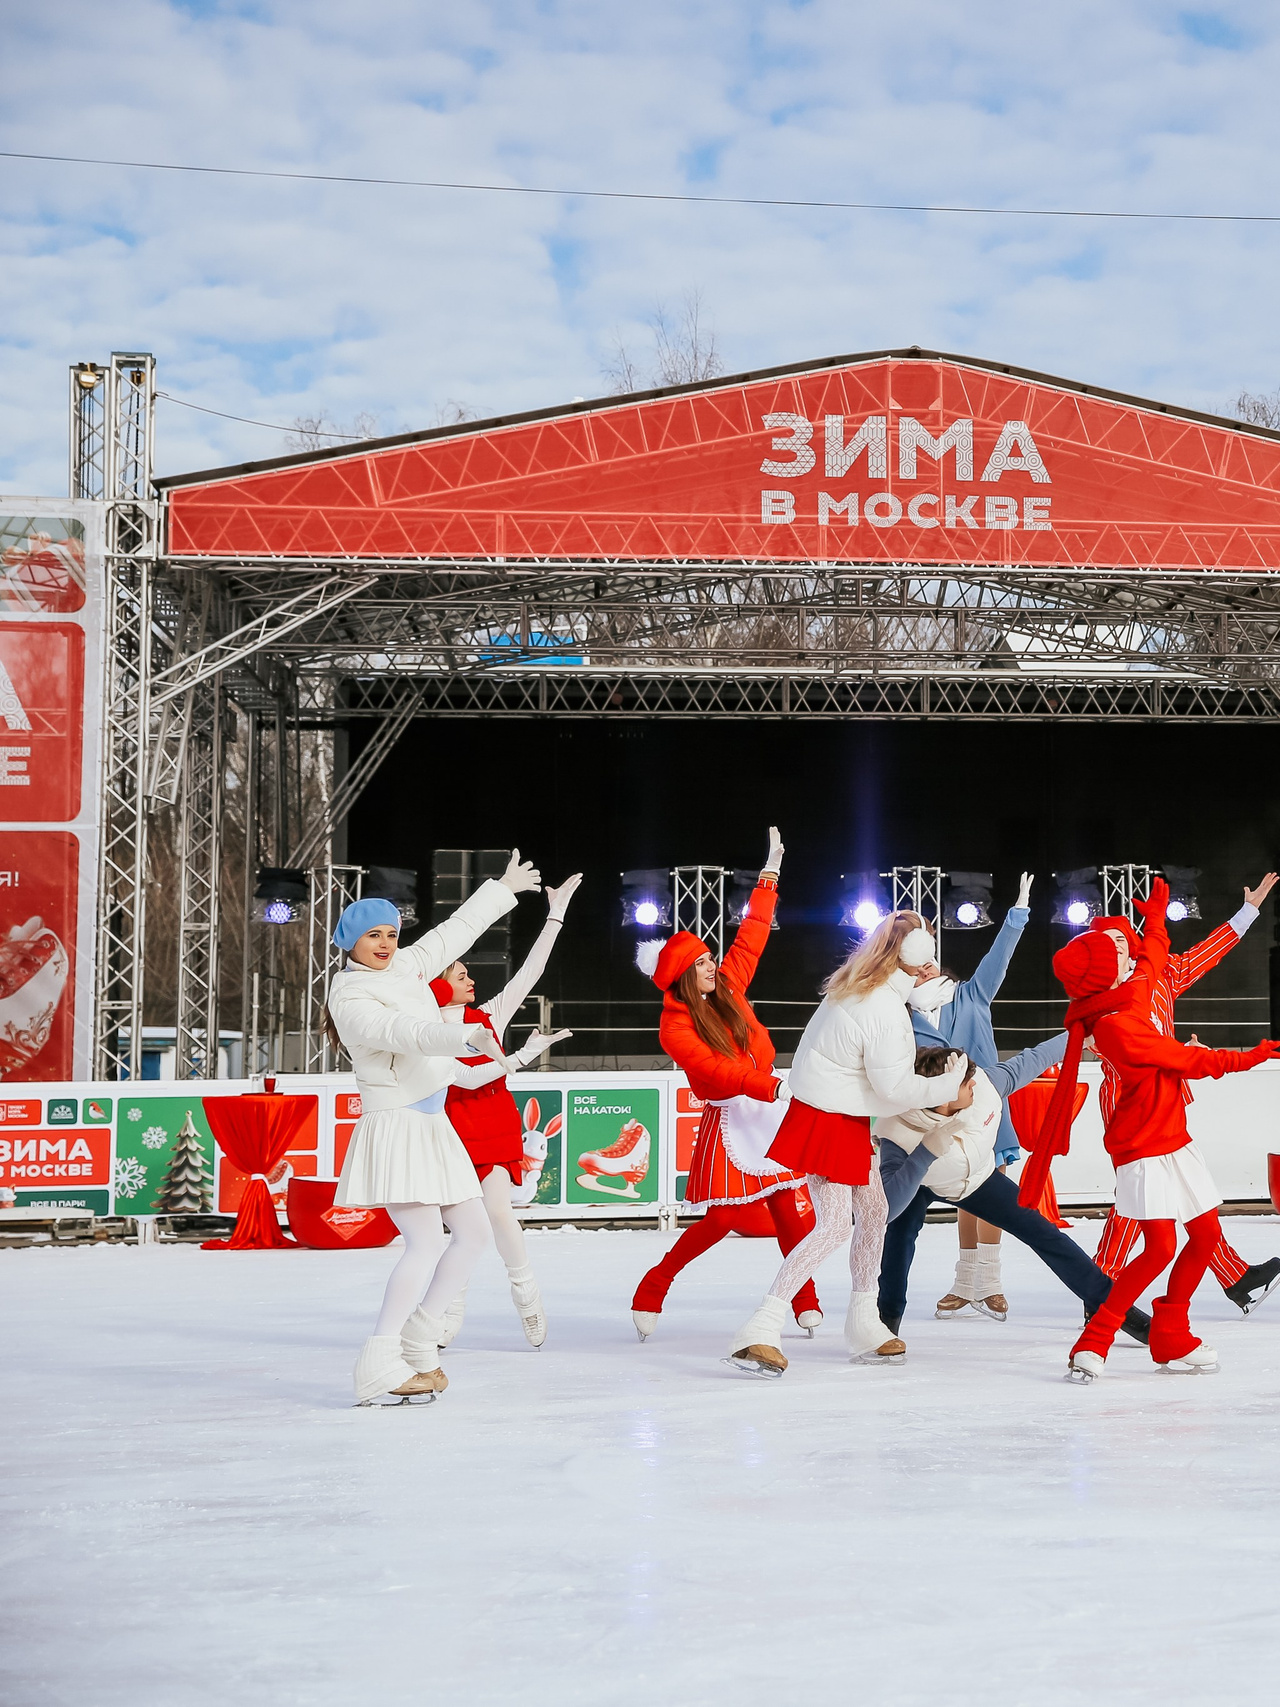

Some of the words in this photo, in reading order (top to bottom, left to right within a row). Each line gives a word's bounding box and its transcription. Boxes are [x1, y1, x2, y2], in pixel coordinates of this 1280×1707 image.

[759, 412, 1052, 483] ЗИМА
[761, 490, 796, 524] В
[818, 492, 1052, 531] МОСКВЕ
[574, 1096, 597, 1105] ВСЕ
[574, 1106, 591, 1115] НА
[592, 1105, 632, 1115] КАТОК!
[10, 1163, 93, 1178] МОСКВЕ
